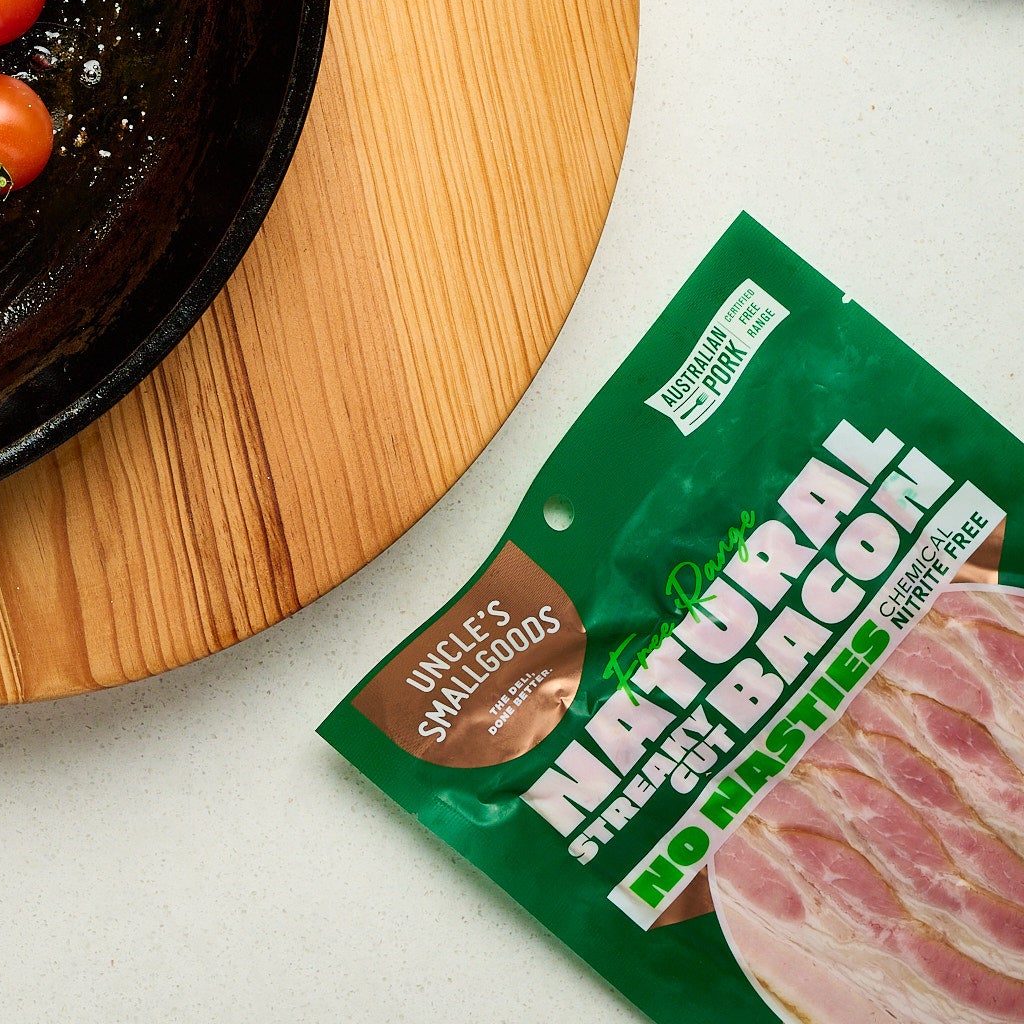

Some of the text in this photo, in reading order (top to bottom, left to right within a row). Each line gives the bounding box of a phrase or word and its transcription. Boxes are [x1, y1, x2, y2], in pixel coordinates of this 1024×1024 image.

[724, 288, 755, 323] CERTIFIED
[738, 302, 761, 325] FREE
[746, 308, 776, 338] RANGE
[660, 325, 727, 407] AUSTRALIAN
[701, 339, 748, 396] PORK
[602, 510, 756, 707] Free Range
[705, 446, 955, 734] BACON
[879, 527, 953, 617] CHEMICAL
[890, 511, 989, 630] NITRITE FREE
[406, 600, 511, 693] UNCLE'S
[519, 418, 905, 838] NATURAL
[418, 605, 561, 743] SMALLGOODS
[487, 668, 553, 736] DONE BETTER.
[489, 672, 536, 716] THE DELI,
[568, 704, 713, 866] STREAKY
[629, 618, 891, 909] NO NASTIES
[670, 723, 735, 794] CUT
